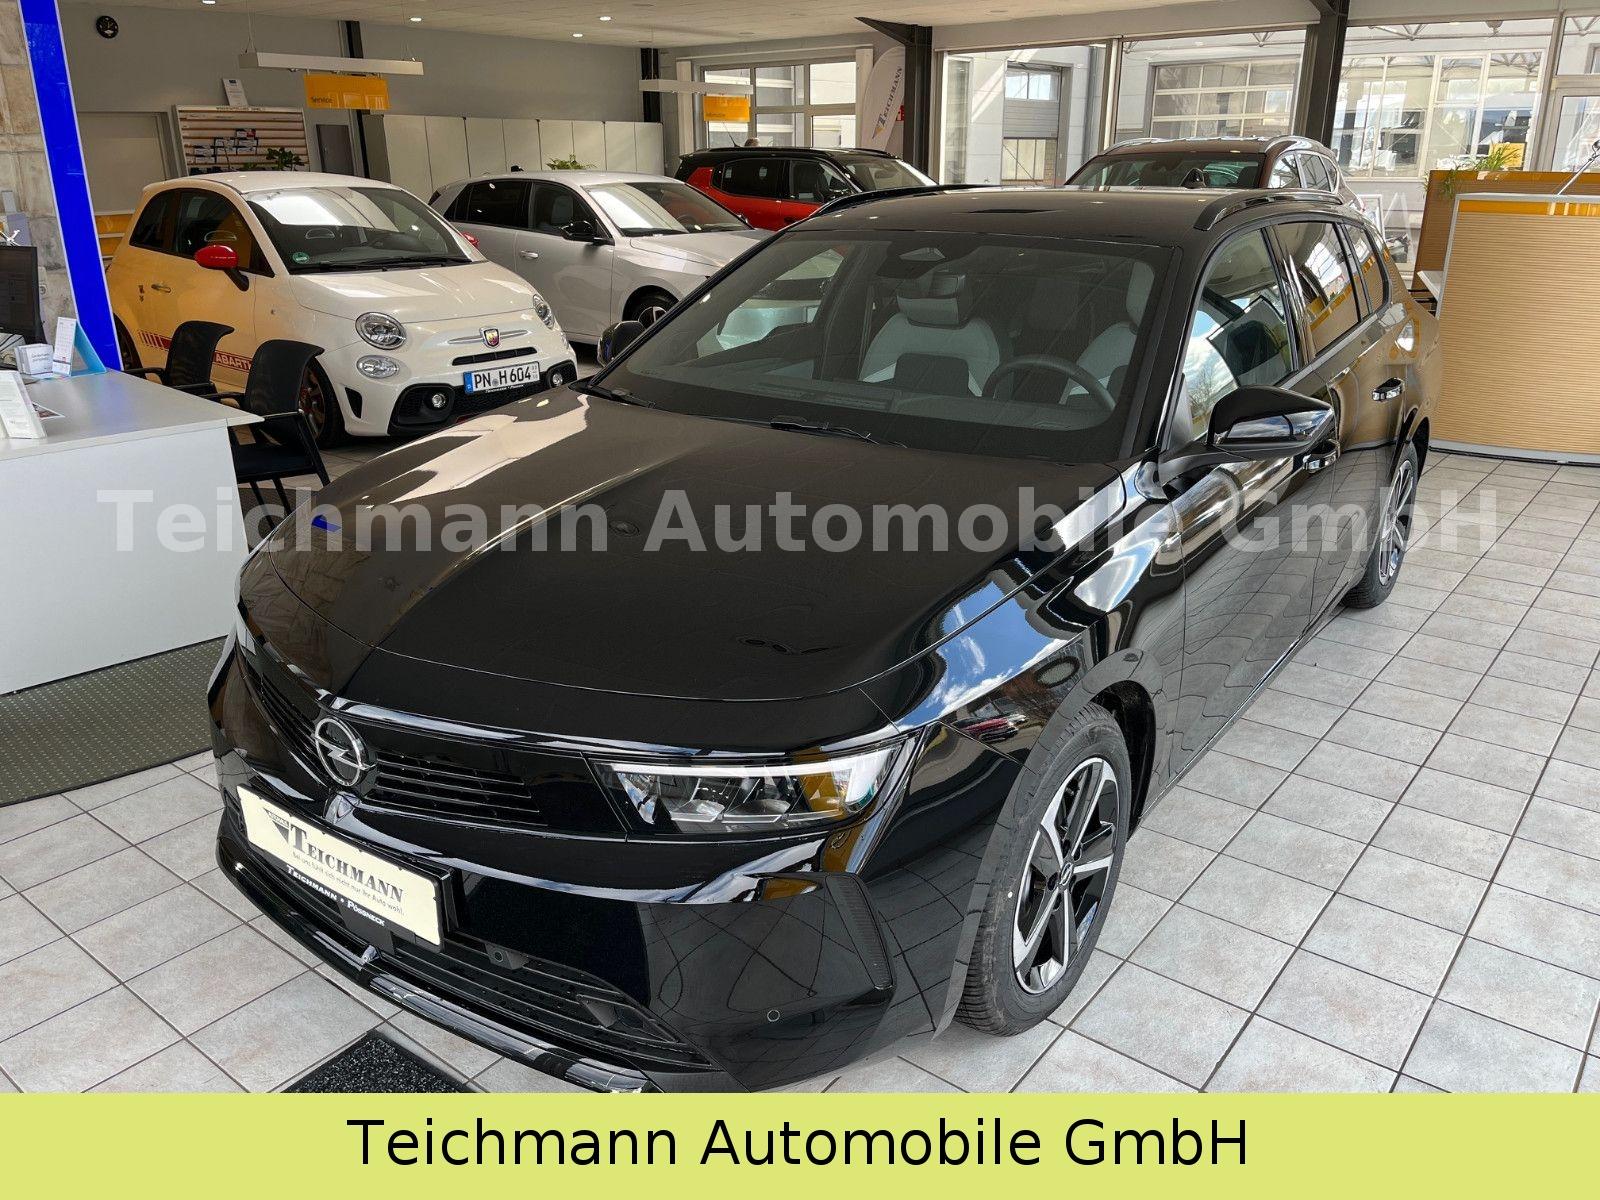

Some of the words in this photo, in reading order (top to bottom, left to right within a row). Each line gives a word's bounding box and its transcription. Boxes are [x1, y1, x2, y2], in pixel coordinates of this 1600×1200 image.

[878, 66, 903, 127] TEICHMANN
[474, 372, 492, 389] PN
[499, 370, 508, 385] H
[510, 366, 532, 383] 604
[286, 864, 338, 901] TEICHMANN
[290, 823, 403, 903] TEICHMANN
